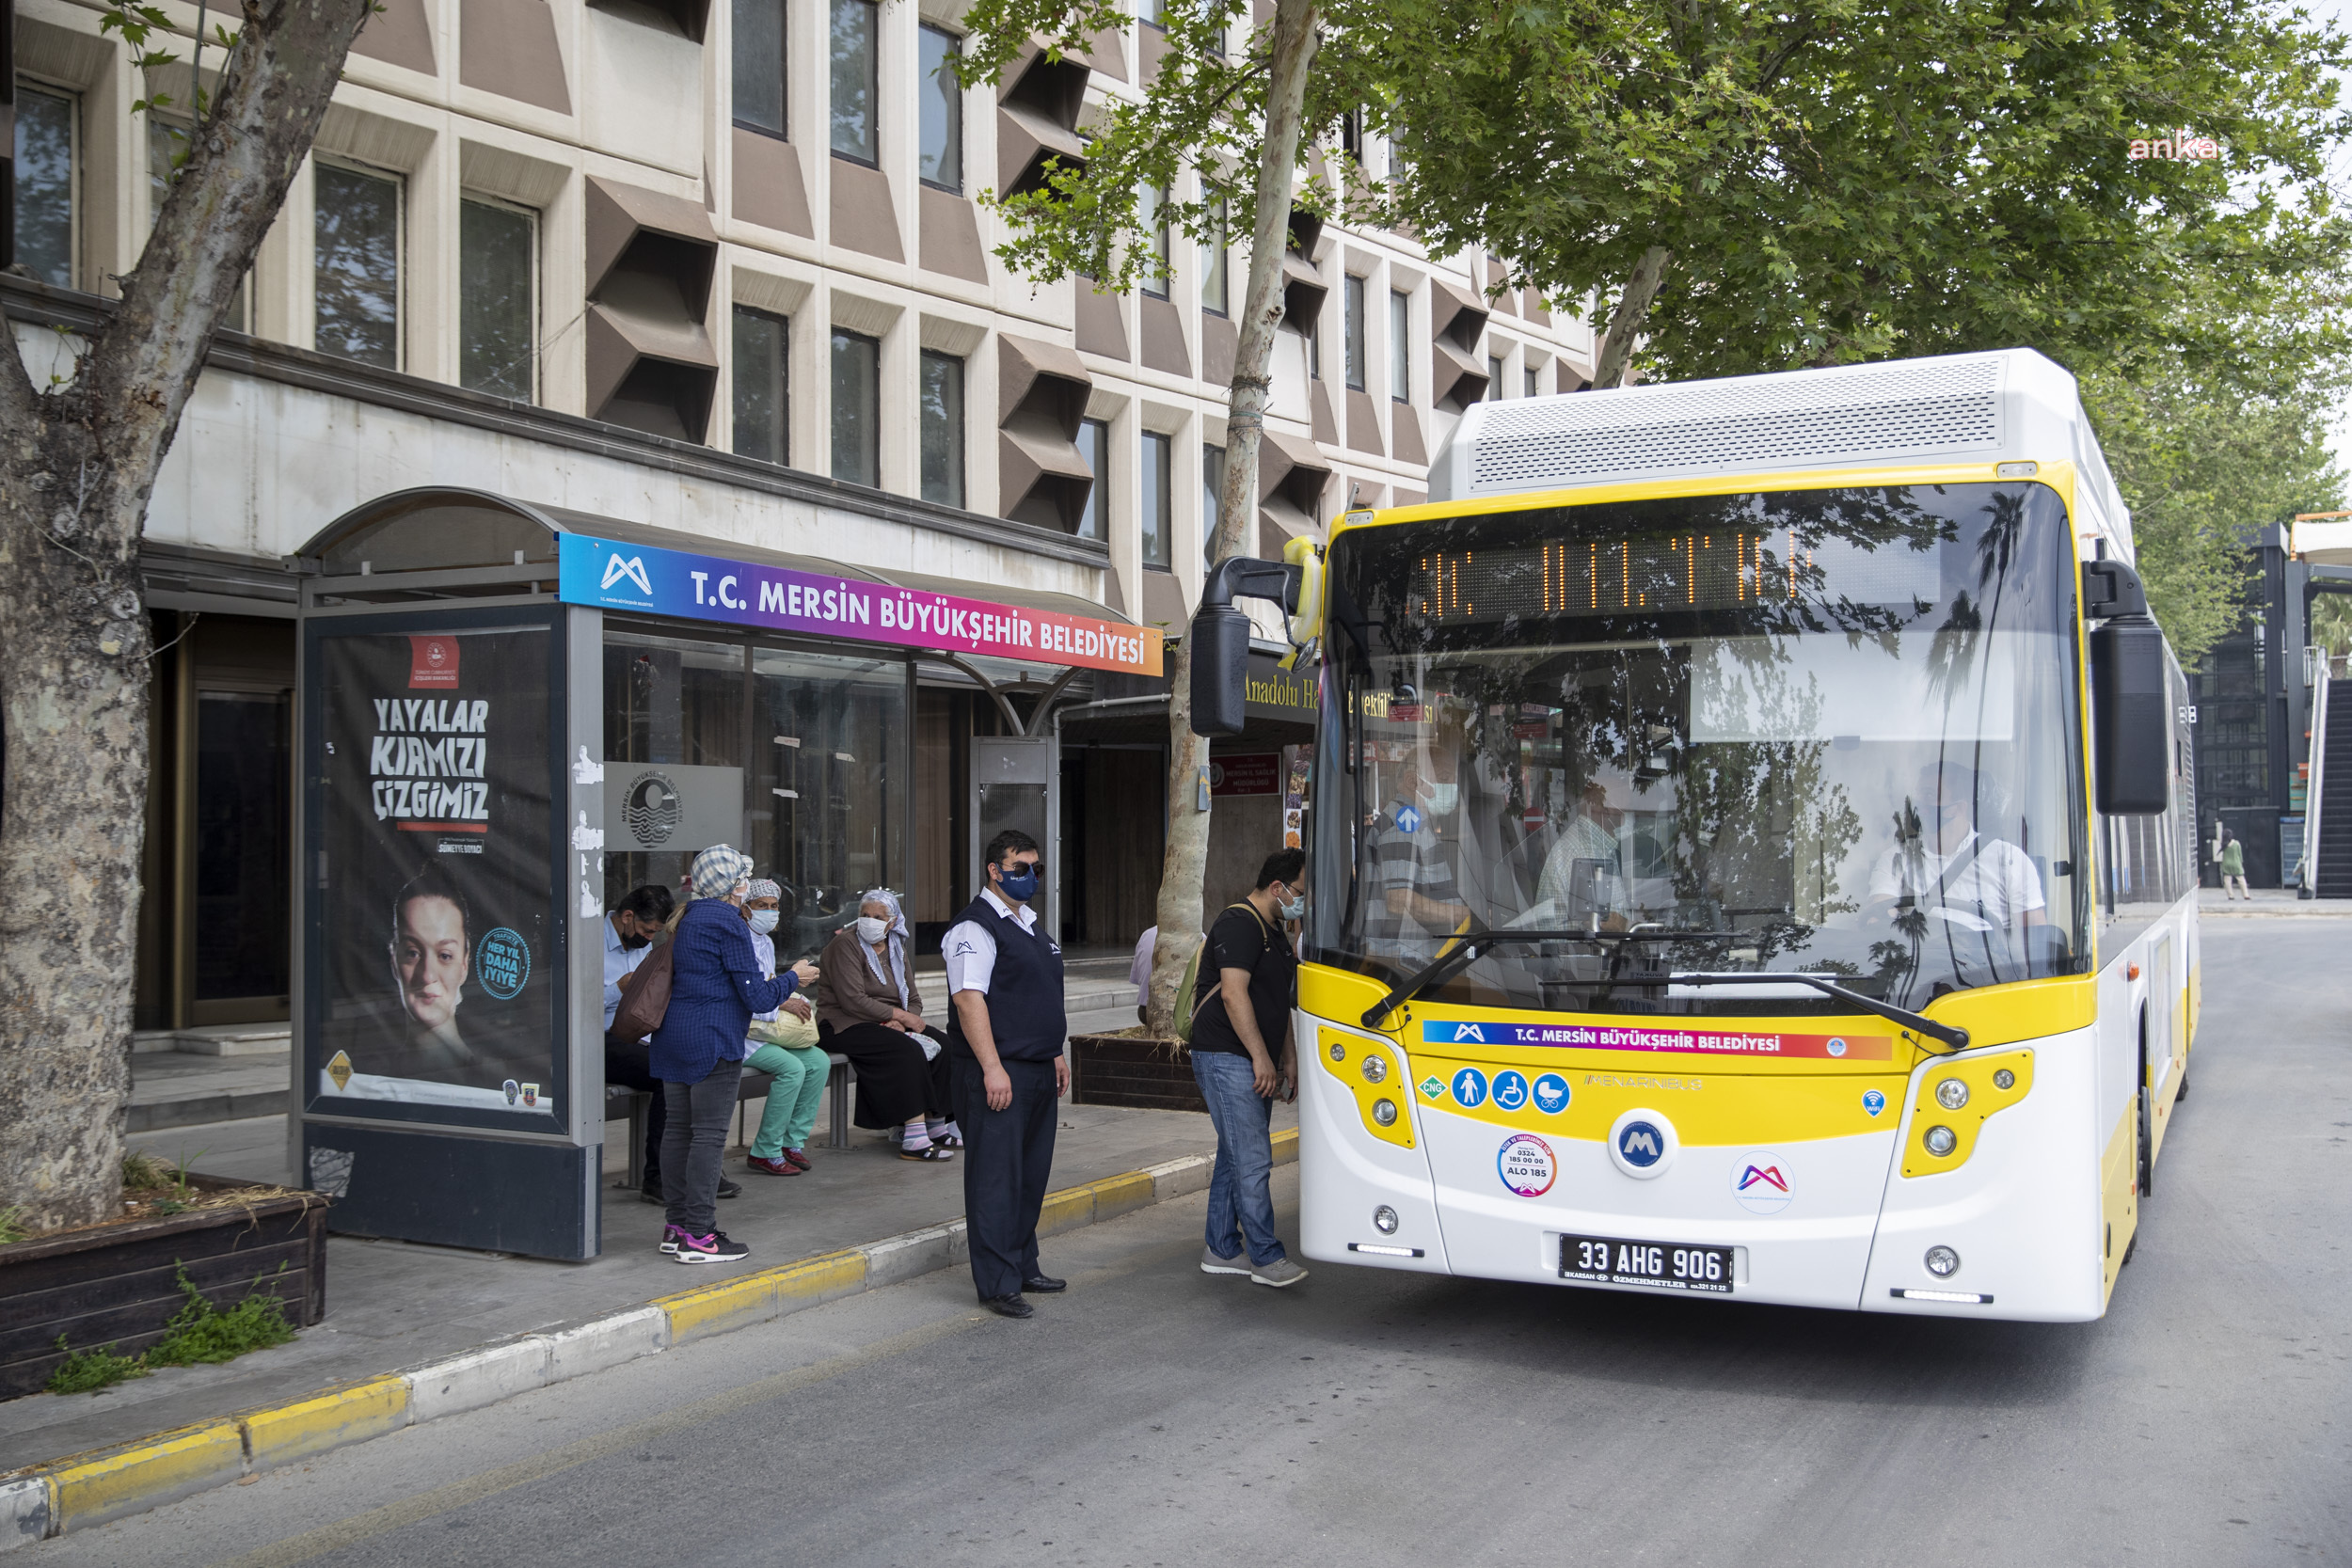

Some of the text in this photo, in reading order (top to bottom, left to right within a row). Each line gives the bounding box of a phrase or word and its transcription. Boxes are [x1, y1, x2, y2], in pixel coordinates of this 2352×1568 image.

[691, 571, 1145, 665] T.C. MERSİN BÜYÜKŞEHİR BELEDİYESİ
[1246, 670, 1298, 707] Anadolu
[373, 699, 489, 733] YAYALAR
[371, 736, 486, 778] KIRMIZI
[372, 781, 489, 821] ÇİZGİMİZ
[487, 941, 520, 959] HER YIL
[486, 952, 518, 973] DAHA
[485, 965, 518, 988] İYİYE
[1516, 1027, 1780, 1051] T.C. MERSİN BÜYÜKŞEHİR BELEDİYESİ
[1423, 1083, 1442, 1093] CNG
[1590, 1075, 1702, 1090] MENARINIBUS
[1530, 1169, 1546, 1177] 185
[1578, 1241, 1721, 1280] 33 AHG 906
[1570, 1272, 1595, 1280] KARSAN
[1613, 1275, 1686, 1288] ÖZMEHMETLER
